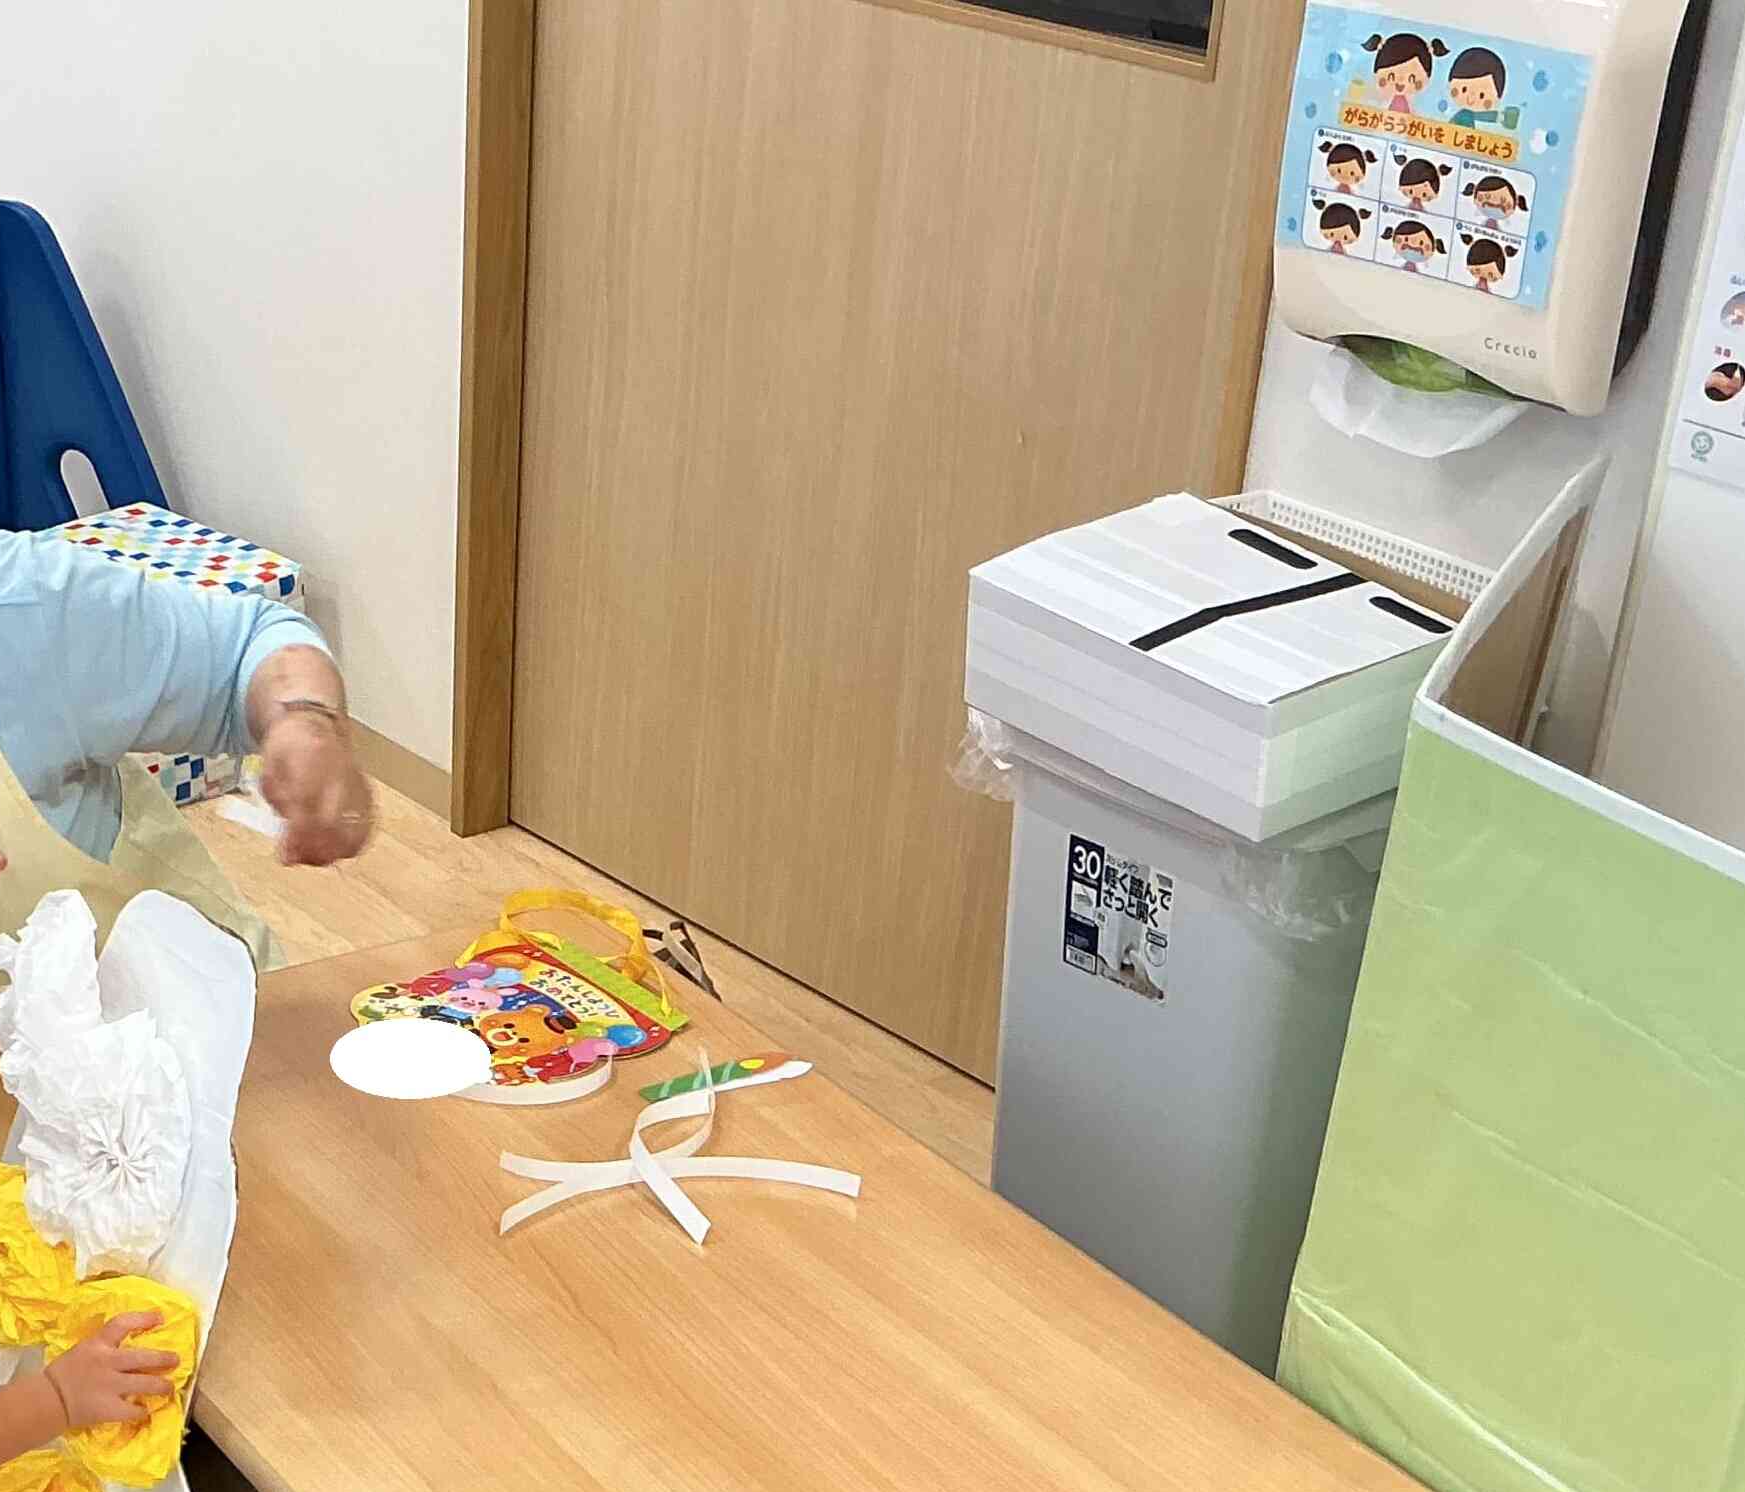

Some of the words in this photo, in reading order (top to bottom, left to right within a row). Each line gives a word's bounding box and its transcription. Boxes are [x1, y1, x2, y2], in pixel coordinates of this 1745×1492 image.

[1343, 107, 1446, 143] がらがらうがいを
[1453, 131, 1514, 159] しましょう
[1072, 845, 1101, 879] 30
[1103, 888, 1158, 928] さっと開く
[1104, 864, 1173, 911] 軽く踏んで
